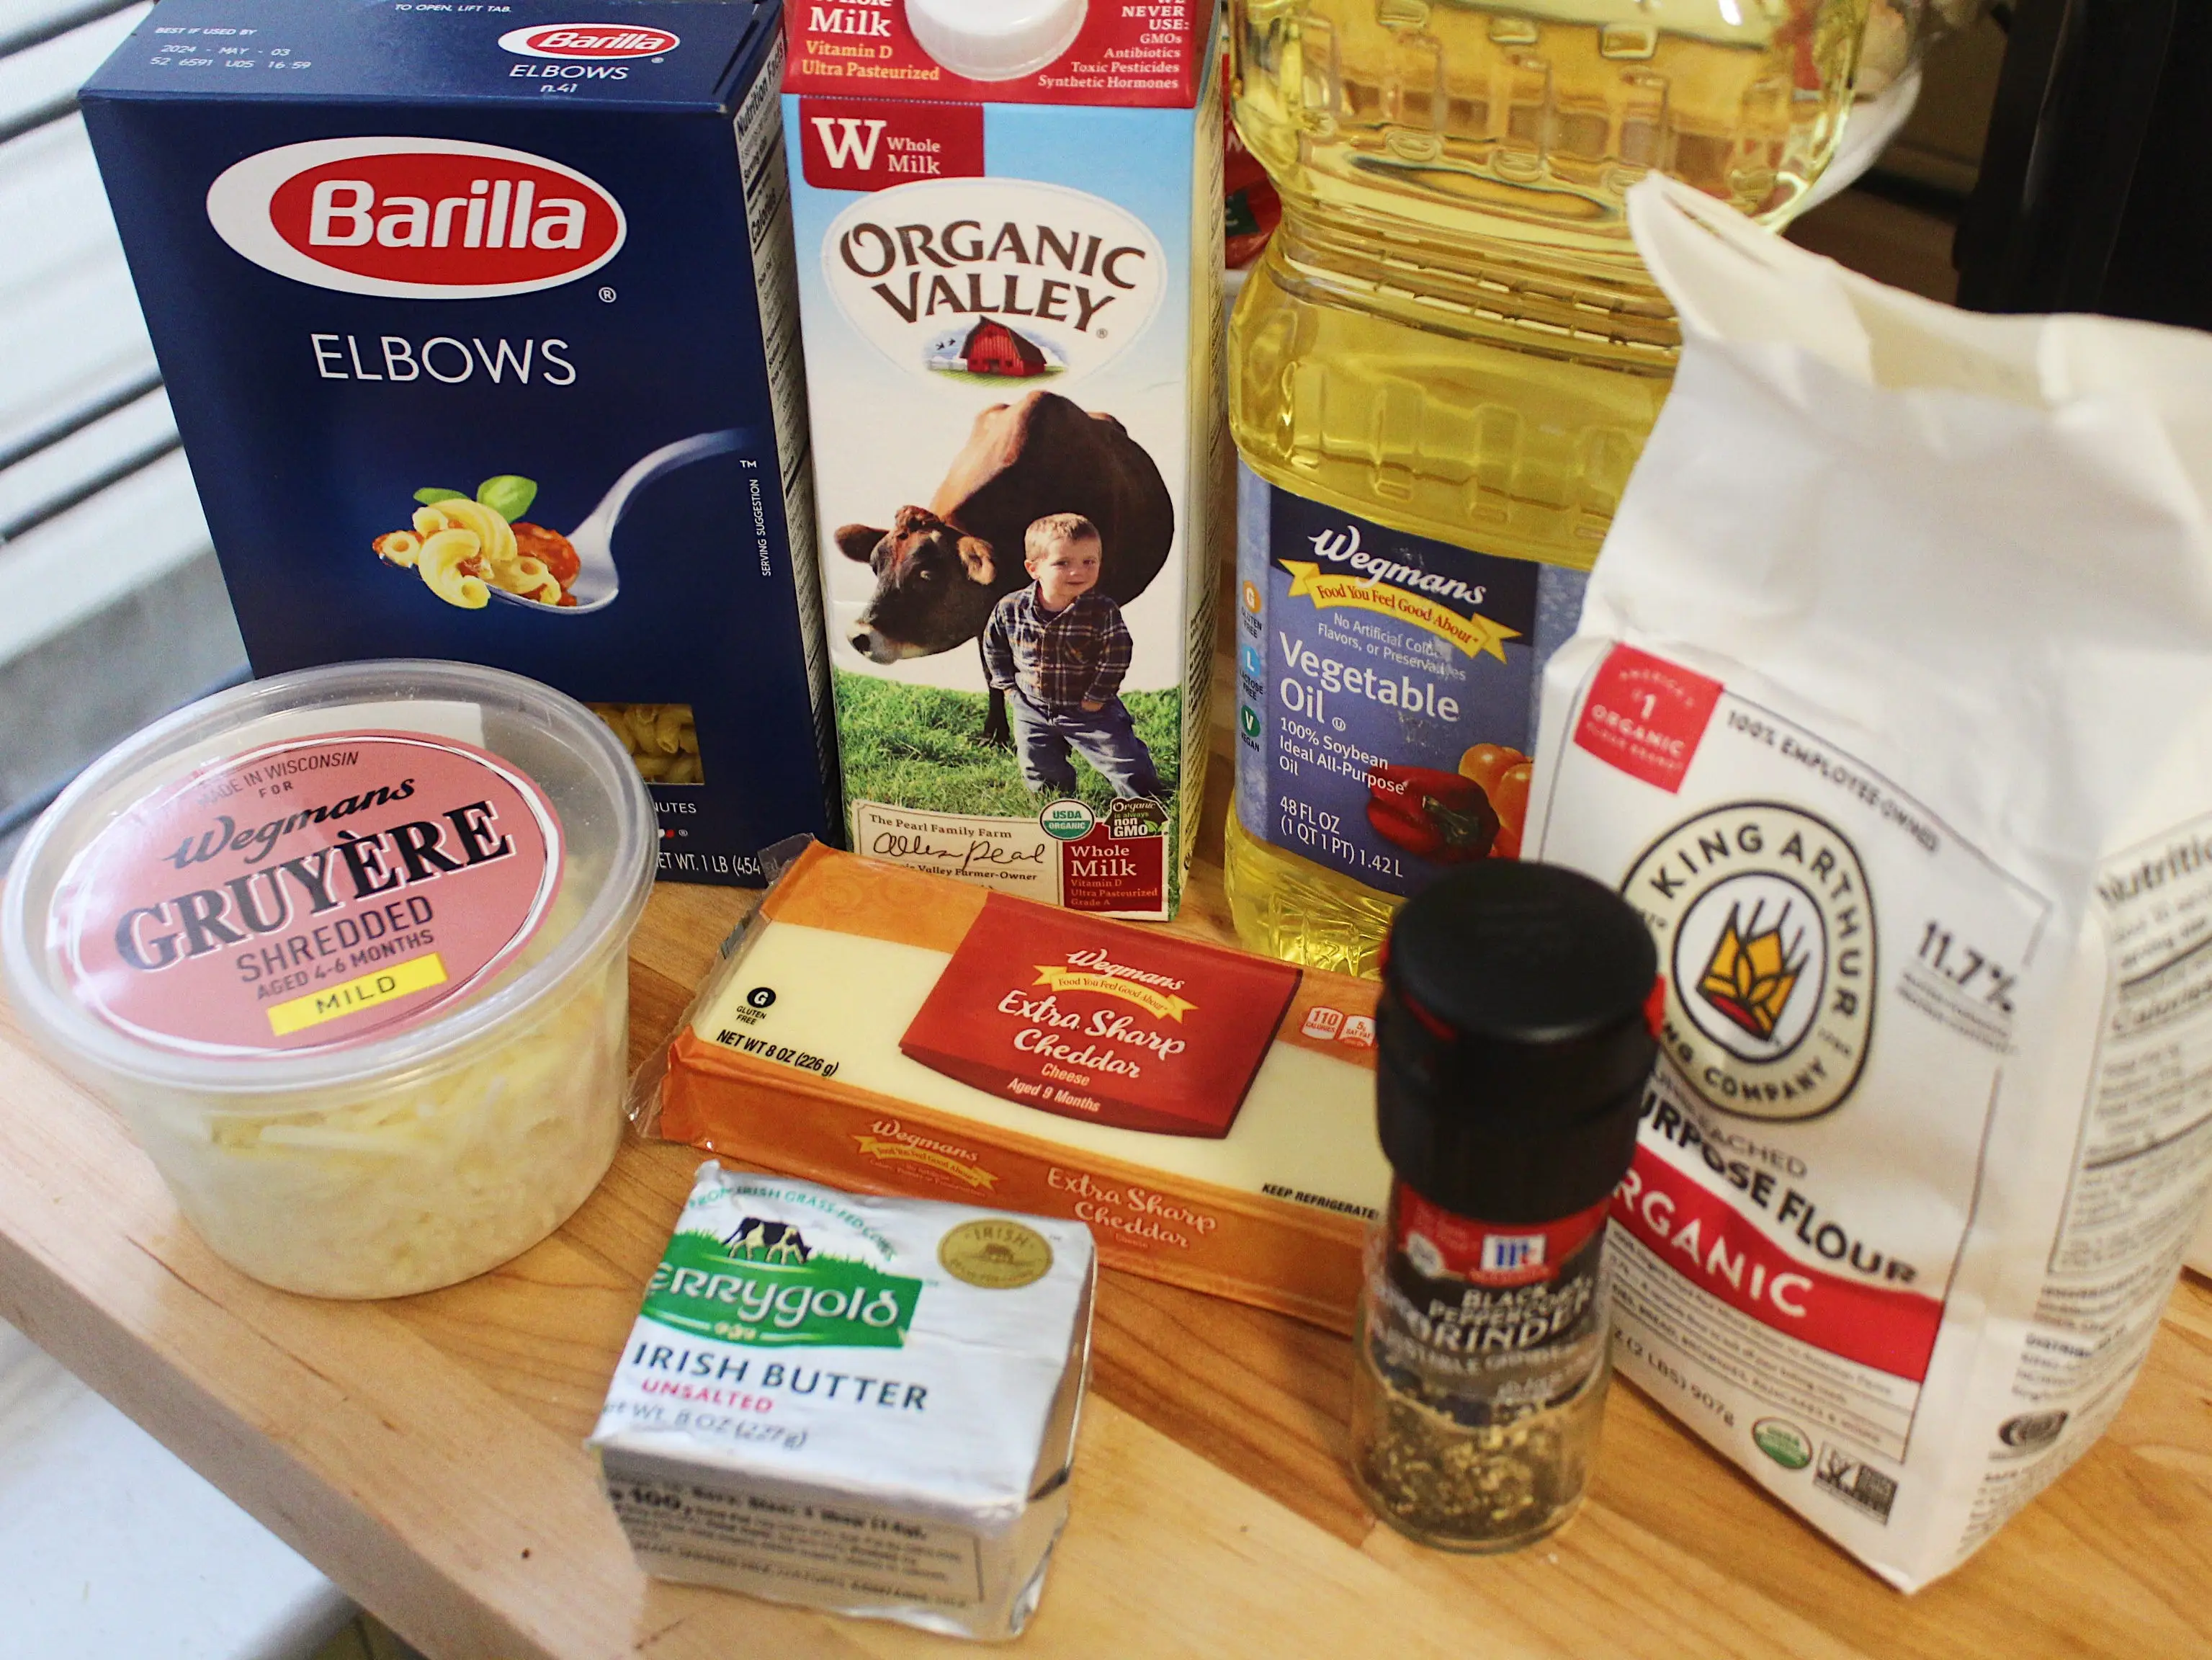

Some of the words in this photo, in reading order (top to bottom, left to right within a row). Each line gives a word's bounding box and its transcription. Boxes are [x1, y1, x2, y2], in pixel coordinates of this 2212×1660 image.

[808, 6, 892, 37] Milk
[1121, 6, 1185, 17] NEVER
[1149, 19, 1190, 30] USE:
[161, 45, 197, 53] 2024
[537, 32, 664, 51] Barilla
[806, 40, 875, 58] Vitamin
[879, 45, 893, 59] D
[1103, 48, 1181, 58] Antibiotics
[1139, 33, 1183, 44] GMOs
[179, 58, 213, 67] 6591
[509, 64, 630, 81] ELBOWS
[802, 59, 843, 76] Ultra
[846, 62, 940, 81] Pasteurized
[1071, 61, 1109, 73] Toxic
[1111, 61, 1181, 73] Pesticides
[539, 83, 578, 94] n.41
[1038, 75, 1106, 89] Synthetic
[1107, 76, 1179, 89] Hormones
[811, 117, 887, 171] W
[887, 136, 941, 153] Whole
[887, 154, 941, 175] Milk
[309, 179, 586, 249] Barilla
[840, 220, 1145, 290] ORGANIC
[871, 271, 1116, 332] VALLEY
[310, 334, 576, 385] ELBOWS
[749, 479, 766, 536] SUGGESTION
[758, 539, 771, 576] SERVING
[1307, 525, 1487, 604] Wegmans
[1316, 585, 1346, 599] Food
[1347, 585, 1369, 601] You
[1372, 587, 1395, 609] Feel
[1398, 599, 1433, 621] Good
[1318, 622, 1362, 651] Flavors,
[1366, 643, 1379, 655] or
[1334, 612, 1350, 628] No
[1353, 620, 1404, 646] Artificial
[1279, 632, 1460, 723] Vegetable
[1279, 677, 1326, 723] Oil
[1240, 731, 1260, 752] VEGAN
[1281, 717, 1320, 746] 100%
[1323, 735, 1389, 770] Soybean
[1591, 704, 1686, 759] ORGANIC
[244, 769, 263, 787] IN
[264, 751, 359, 780] WISCONSIN
[1279, 756, 1299, 776] Oil
[1280, 735, 1314, 764] Ideal
[1317, 753, 1405, 795] All-Purpose
[258, 780, 294, 798] FOR
[161, 777, 416, 870] Wegmans
[1052, 811, 1083, 819] USDA
[1113, 802, 1155, 813] Organic
[1280, 796, 1297, 816] 48
[1300, 803, 1316, 825] FL
[1319, 811, 1340, 835] OZ
[869, 813, 892, 826] The
[896, 819, 927, 832] Pearl
[931, 824, 975, 838] Family
[978, 829, 1012, 838] Farm
[1114, 825, 1148, 837] GMO
[675, 853, 699, 870] WT.
[702, 855, 708, 872] 1
[712, 855, 728, 873] LB
[1070, 845, 1130, 857] Whole
[1281, 814, 1293, 836] (1
[1297, 823, 1318, 845] QT
[1321, 834, 1327, 849] 1
[1332, 836, 1355, 865] PT)
[1360, 849, 1391, 874] 1.42
[1395, 859, 1403, 878] L
[918, 865, 952, 876] Valley
[955, 868, 1037, 880] Farmer-Owner
[1071, 859, 1137, 877] Milk
[1071, 878, 1113, 888] Vitamin
[113, 800, 516, 973] GRUYÈRE
[1099, 888, 1158, 897] Pasteurized
[1649, 823, 1764, 901] KING
[1779, 830, 1864, 1019] ARTHUR
[236, 896, 434, 983] SHREDDED
[257, 971, 308, 1000] AGED
[315, 958, 346, 979] 4-6
[351, 929, 434, 968] MONTHS
[1065, 948, 1186, 991] Wegmans
[1918, 920, 2015, 1013] 11.7%
[315, 976, 396, 1014] MILD
[1058, 978, 1080, 986] Food
[1083, 978, 1098, 986] You
[1100, 979, 1118, 990] Feel
[1118, 984, 1142, 998] Good
[736, 1005, 767, 1019] GLUTEN
[736, 1014, 757, 1025] FREE
[998, 989, 1081, 1030] Extra
[1084, 1009, 1186, 1061] Sharp
[1313, 1010, 1339, 1026] 110
[716, 1029, 745, 1047] NET
[743, 1038, 768, 1054] WT
[765, 1045, 777, 1057] 8
[776, 1048, 797, 1063] OZ
[794, 1052, 824, 1071] (226
[821, 1060, 839, 1077] g)
[1013, 1028, 1141, 1079] Cheddar
[1041, 1063, 1091, 1086] Cheese
[1704, 1056, 1827, 1102] COMPANY
[1008, 1078, 1042, 1097] Aged
[1042, 1086, 1054, 1099] 9
[1054, 1089, 1101, 1112] Months
[870, 1119, 978, 1161] Wegmans
[736, 1184, 780, 1200] IRISH
[1047, 1166, 1122, 1205] Extra
[1127, 1187, 1217, 1234] Sharp
[1262, 1182, 1293, 1197] KEEP
[1295, 1191, 1379, 1221] REFRIGERATE
[1074, 1201, 1188, 1247] Cheddar
[1778, 1190, 1918, 1284] FLOUR
[1613, 1169, 1814, 1318] RGANIC
[633, 1342, 749, 1383] IRISH
[761, 1362, 928, 1412] BUTTER
[641, 1377, 775, 1414] UNSALTED
